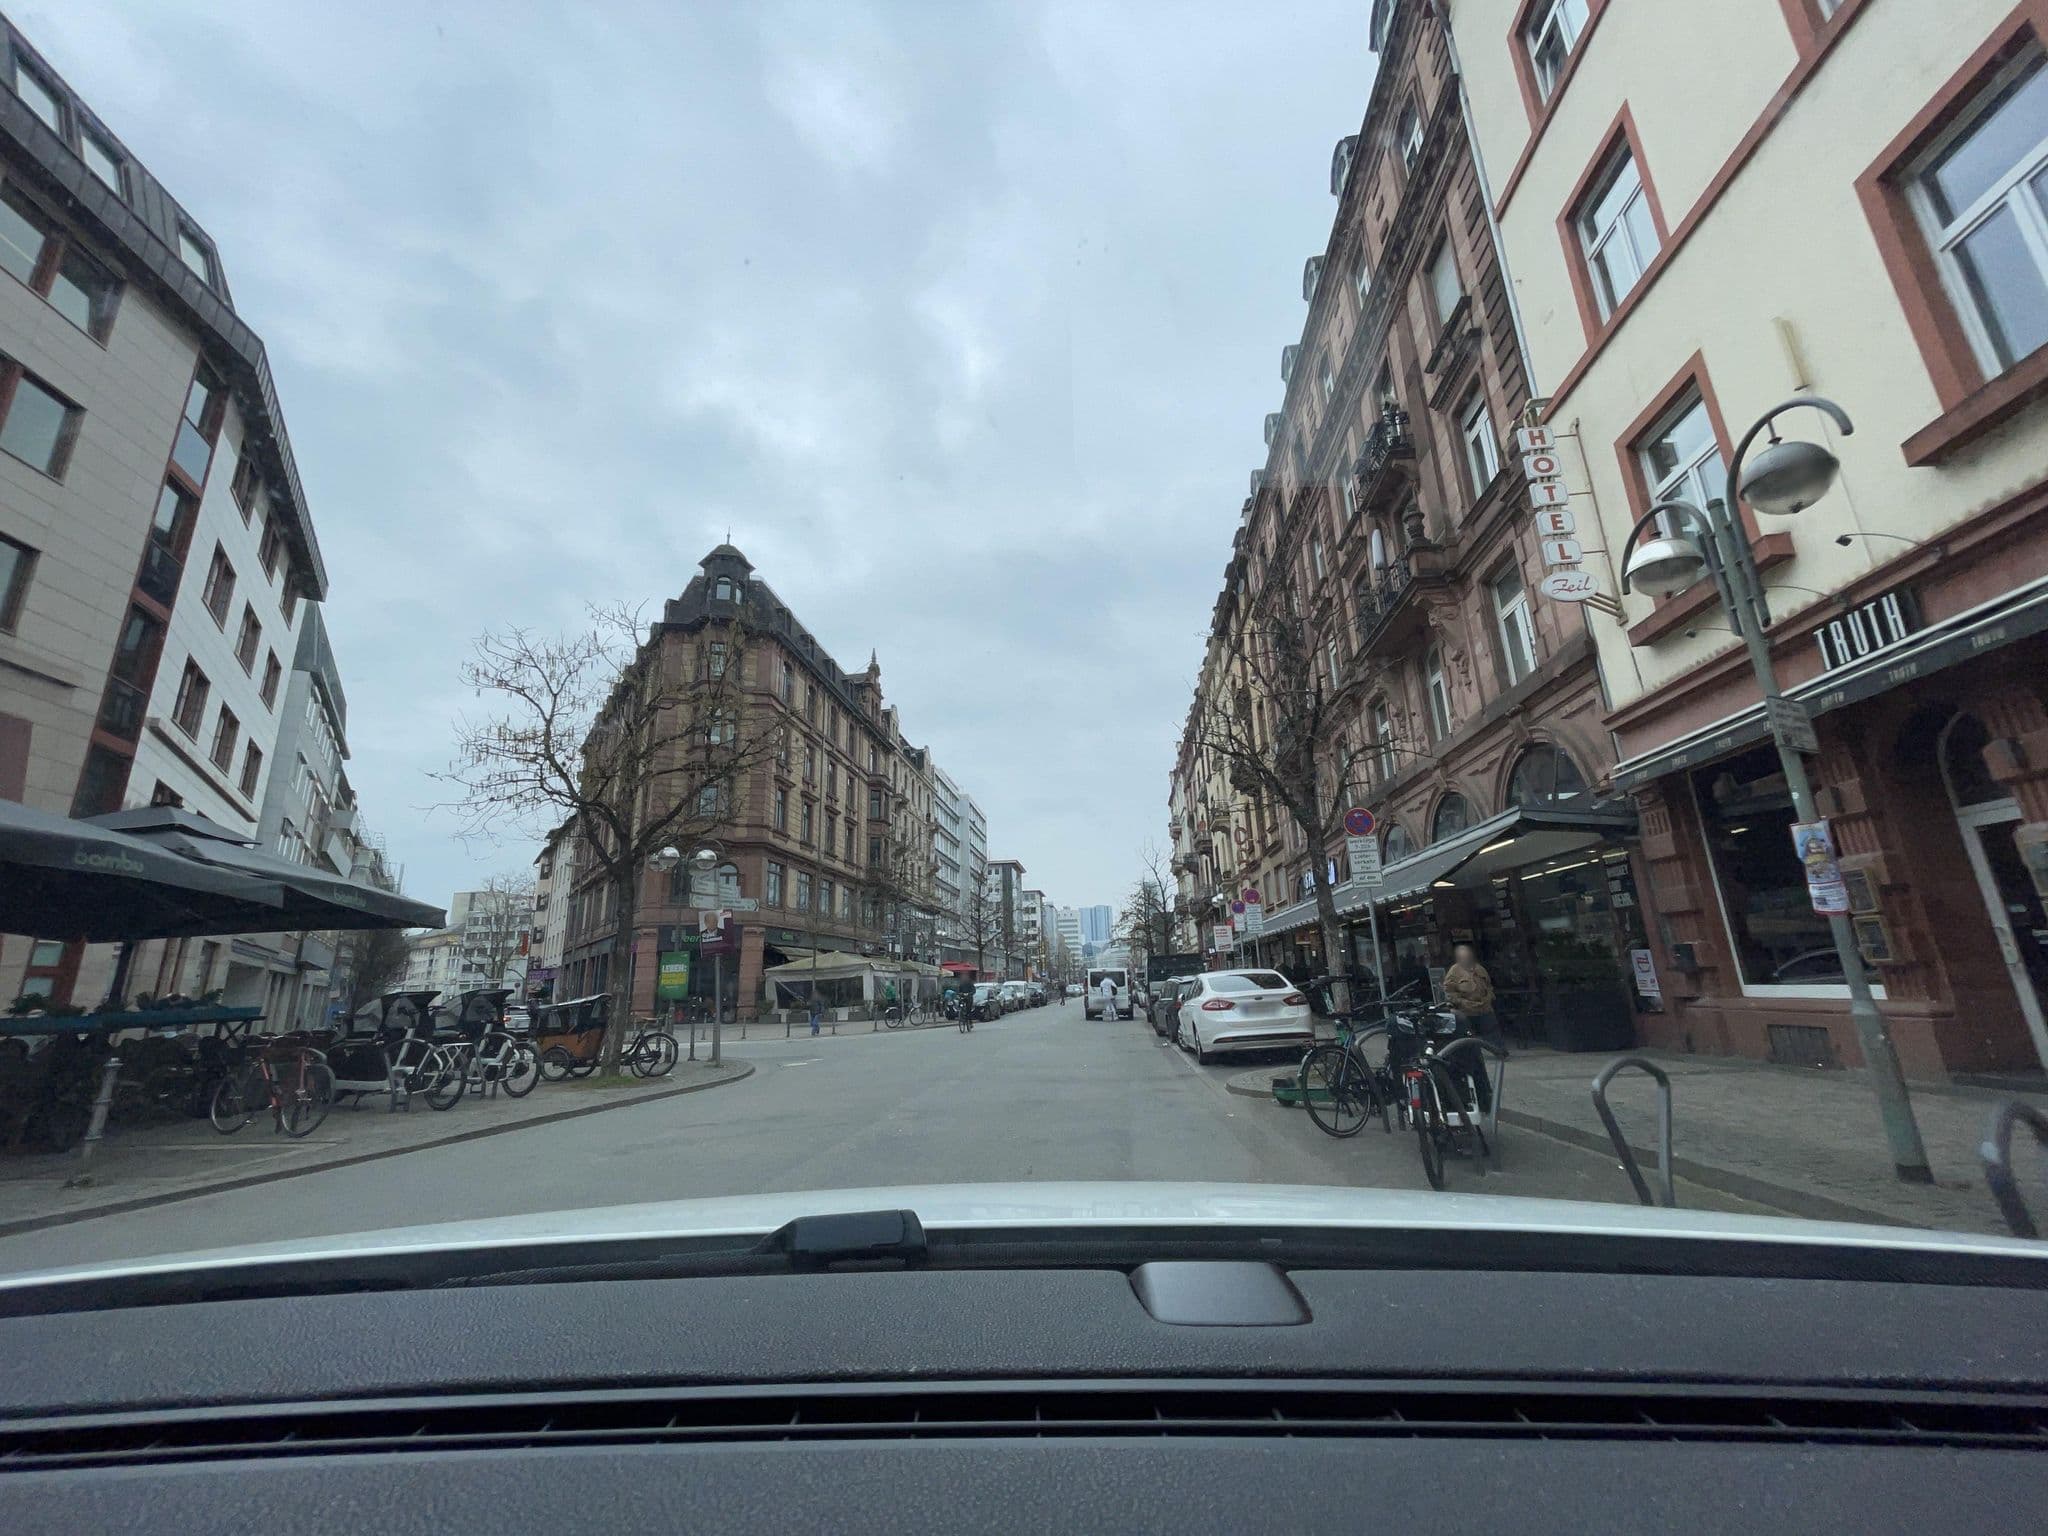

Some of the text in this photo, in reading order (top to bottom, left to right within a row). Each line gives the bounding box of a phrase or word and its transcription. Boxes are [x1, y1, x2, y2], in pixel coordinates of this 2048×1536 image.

[1528, 429, 1573, 561] HOTEL
[1552, 576, 1592, 594] Zeil
[1813, 593, 1907, 671] TRUTH
